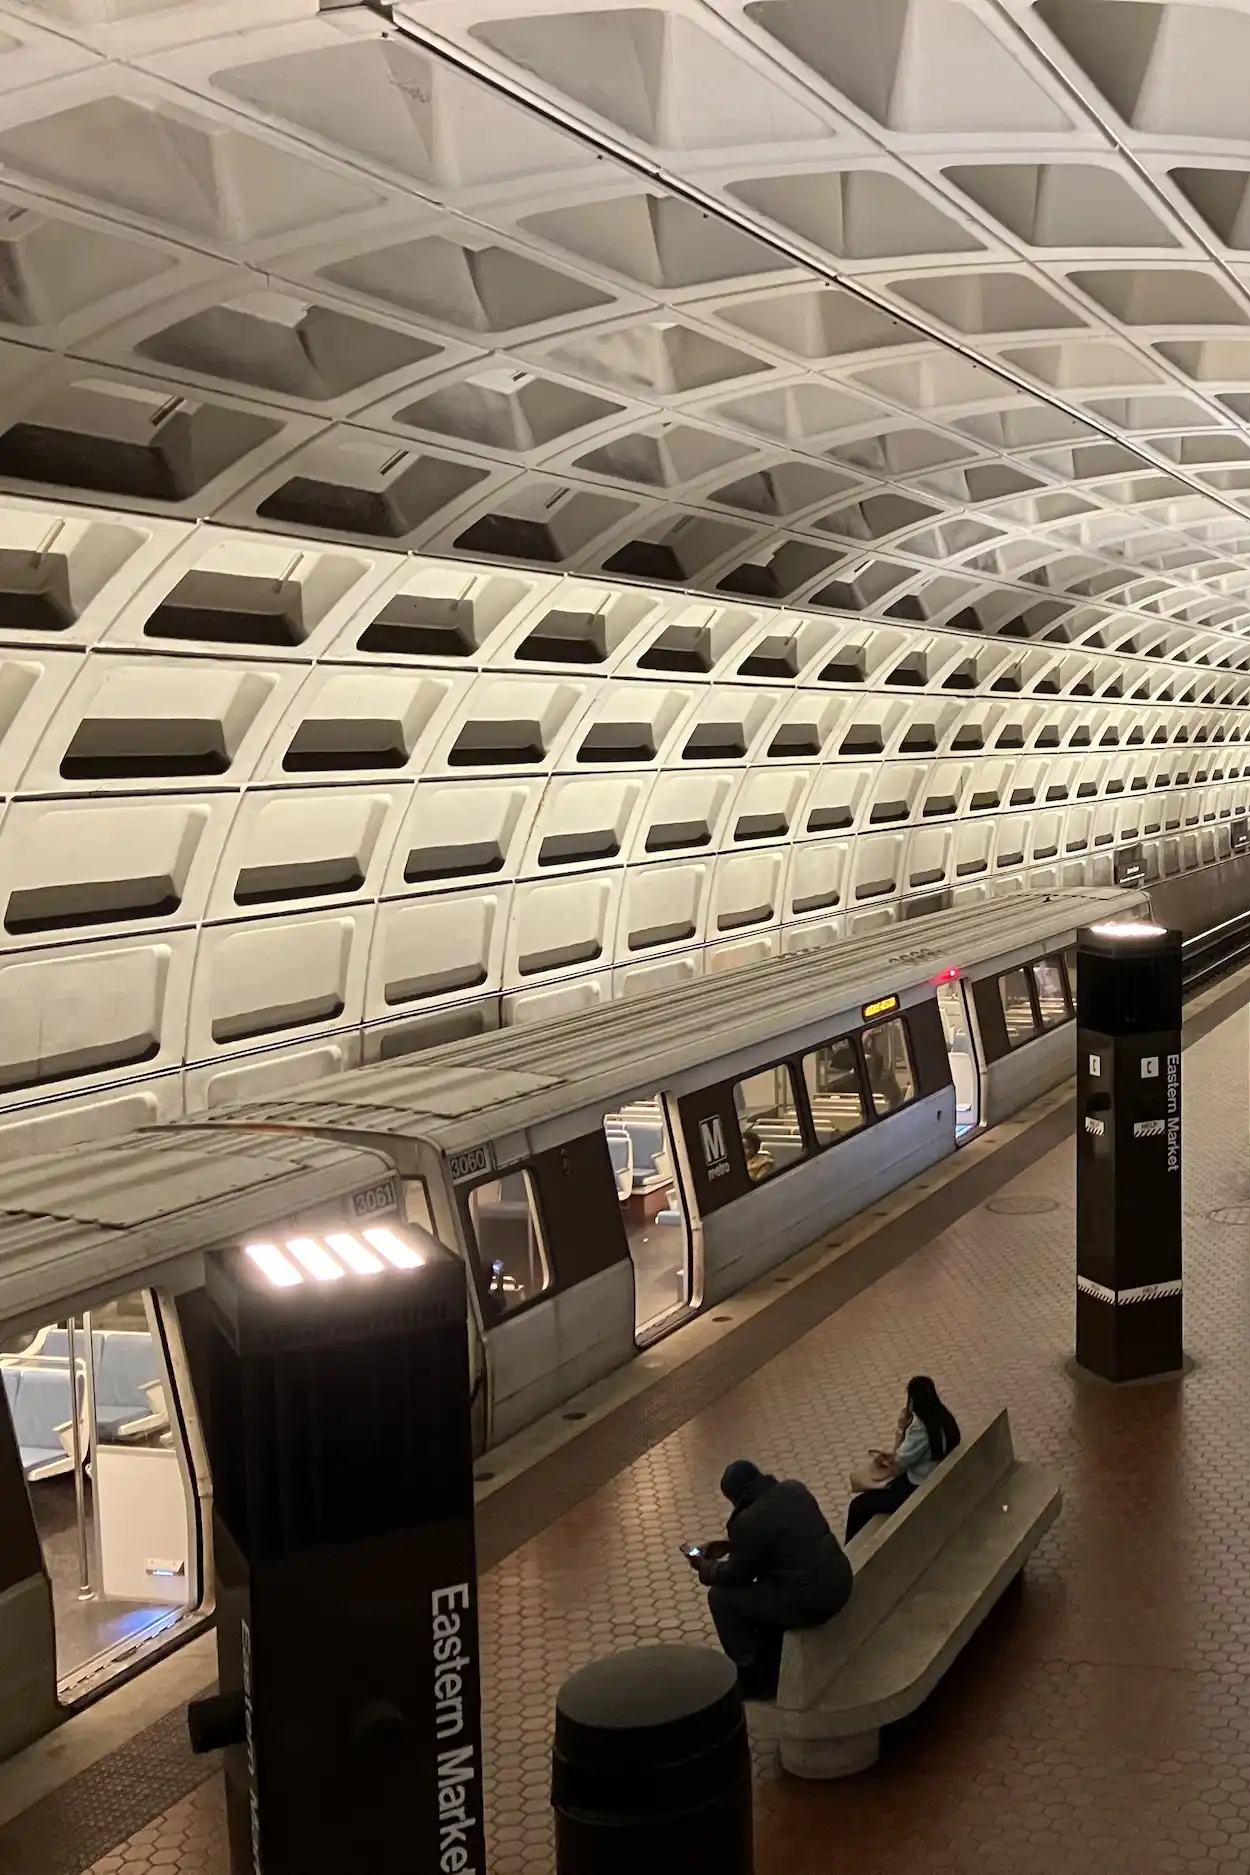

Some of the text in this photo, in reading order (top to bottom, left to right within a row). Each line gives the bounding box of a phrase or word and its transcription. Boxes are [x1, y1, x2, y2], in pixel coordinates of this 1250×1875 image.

[1167, 1054, 1180, 1173] Eastern Market
[355, 1181, 396, 1214] 3061
[449, 1149, 486, 1178] 3060
[708, 1162, 731, 1184] metro
[241, 1618, 254, 1776] Eastern
[431, 1582, 470, 1740] Eastern
